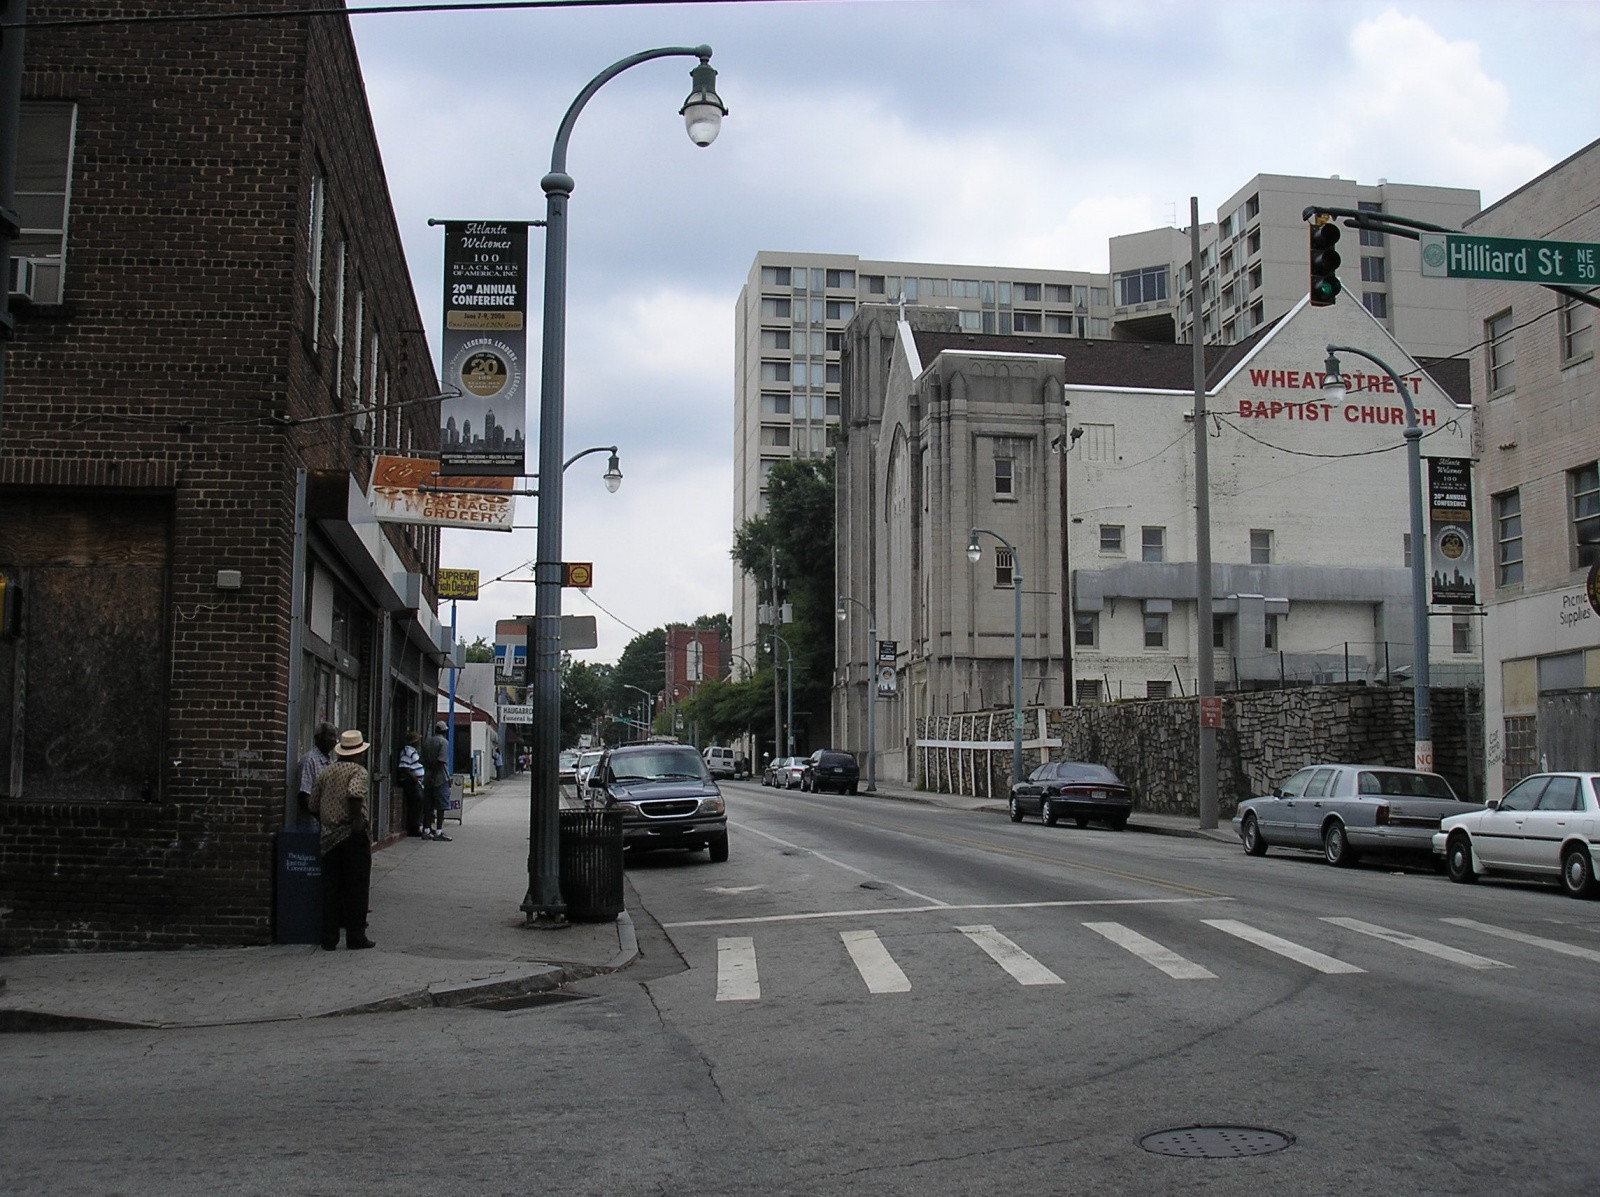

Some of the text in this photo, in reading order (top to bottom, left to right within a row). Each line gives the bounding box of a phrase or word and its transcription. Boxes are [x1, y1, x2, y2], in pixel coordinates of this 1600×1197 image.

[465, 221, 508, 235] Atlanta
[460, 236, 512, 249] Welcomes
[474, 253, 500, 262] 100
[1451, 242, 1564, 276] Hilliard St
[1577, 249, 1594, 264] NE
[1578, 264, 1595, 279] 50
[476, 284, 518, 295] ANNUAL
[452, 295, 515, 306] CONFERENCE
[494, 339, 518, 362] LEADERS
[470, 358, 498, 376] 20
[1249, 368, 1326, 390] WHEAT
[1239, 400, 1332, 422] BAPTIST
[425, 497, 497, 512] PACKAGE
[423, 507, 507, 523] GROCERY
[438, 571, 477, 582] SUPREME
[452, 580, 477, 594] Delight
[1563, 593, 1588, 608] Picnic
[1560, 606, 1591, 628] Supplies
[497, 657, 526, 665] mta
